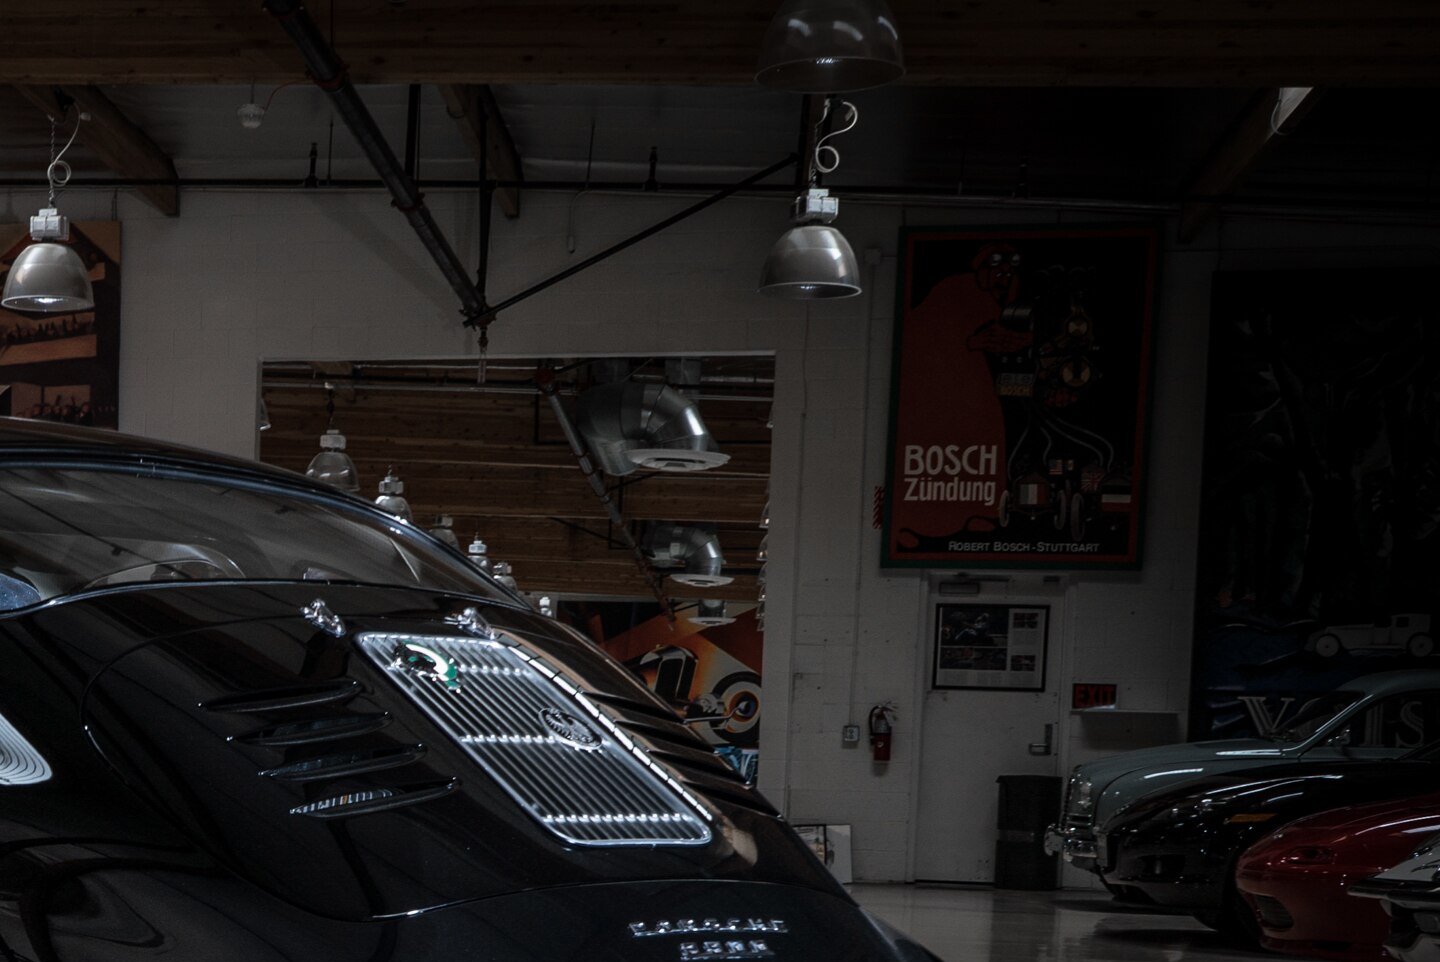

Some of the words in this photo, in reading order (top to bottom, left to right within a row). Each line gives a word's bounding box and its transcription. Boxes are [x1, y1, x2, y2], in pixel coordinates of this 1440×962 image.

[903, 444, 998, 476] BOSCH
[903, 476, 997, 507] Zündung
[947, 540, 990, 552] ROBERT
[1074, 684, 1115, 708] EXIT
